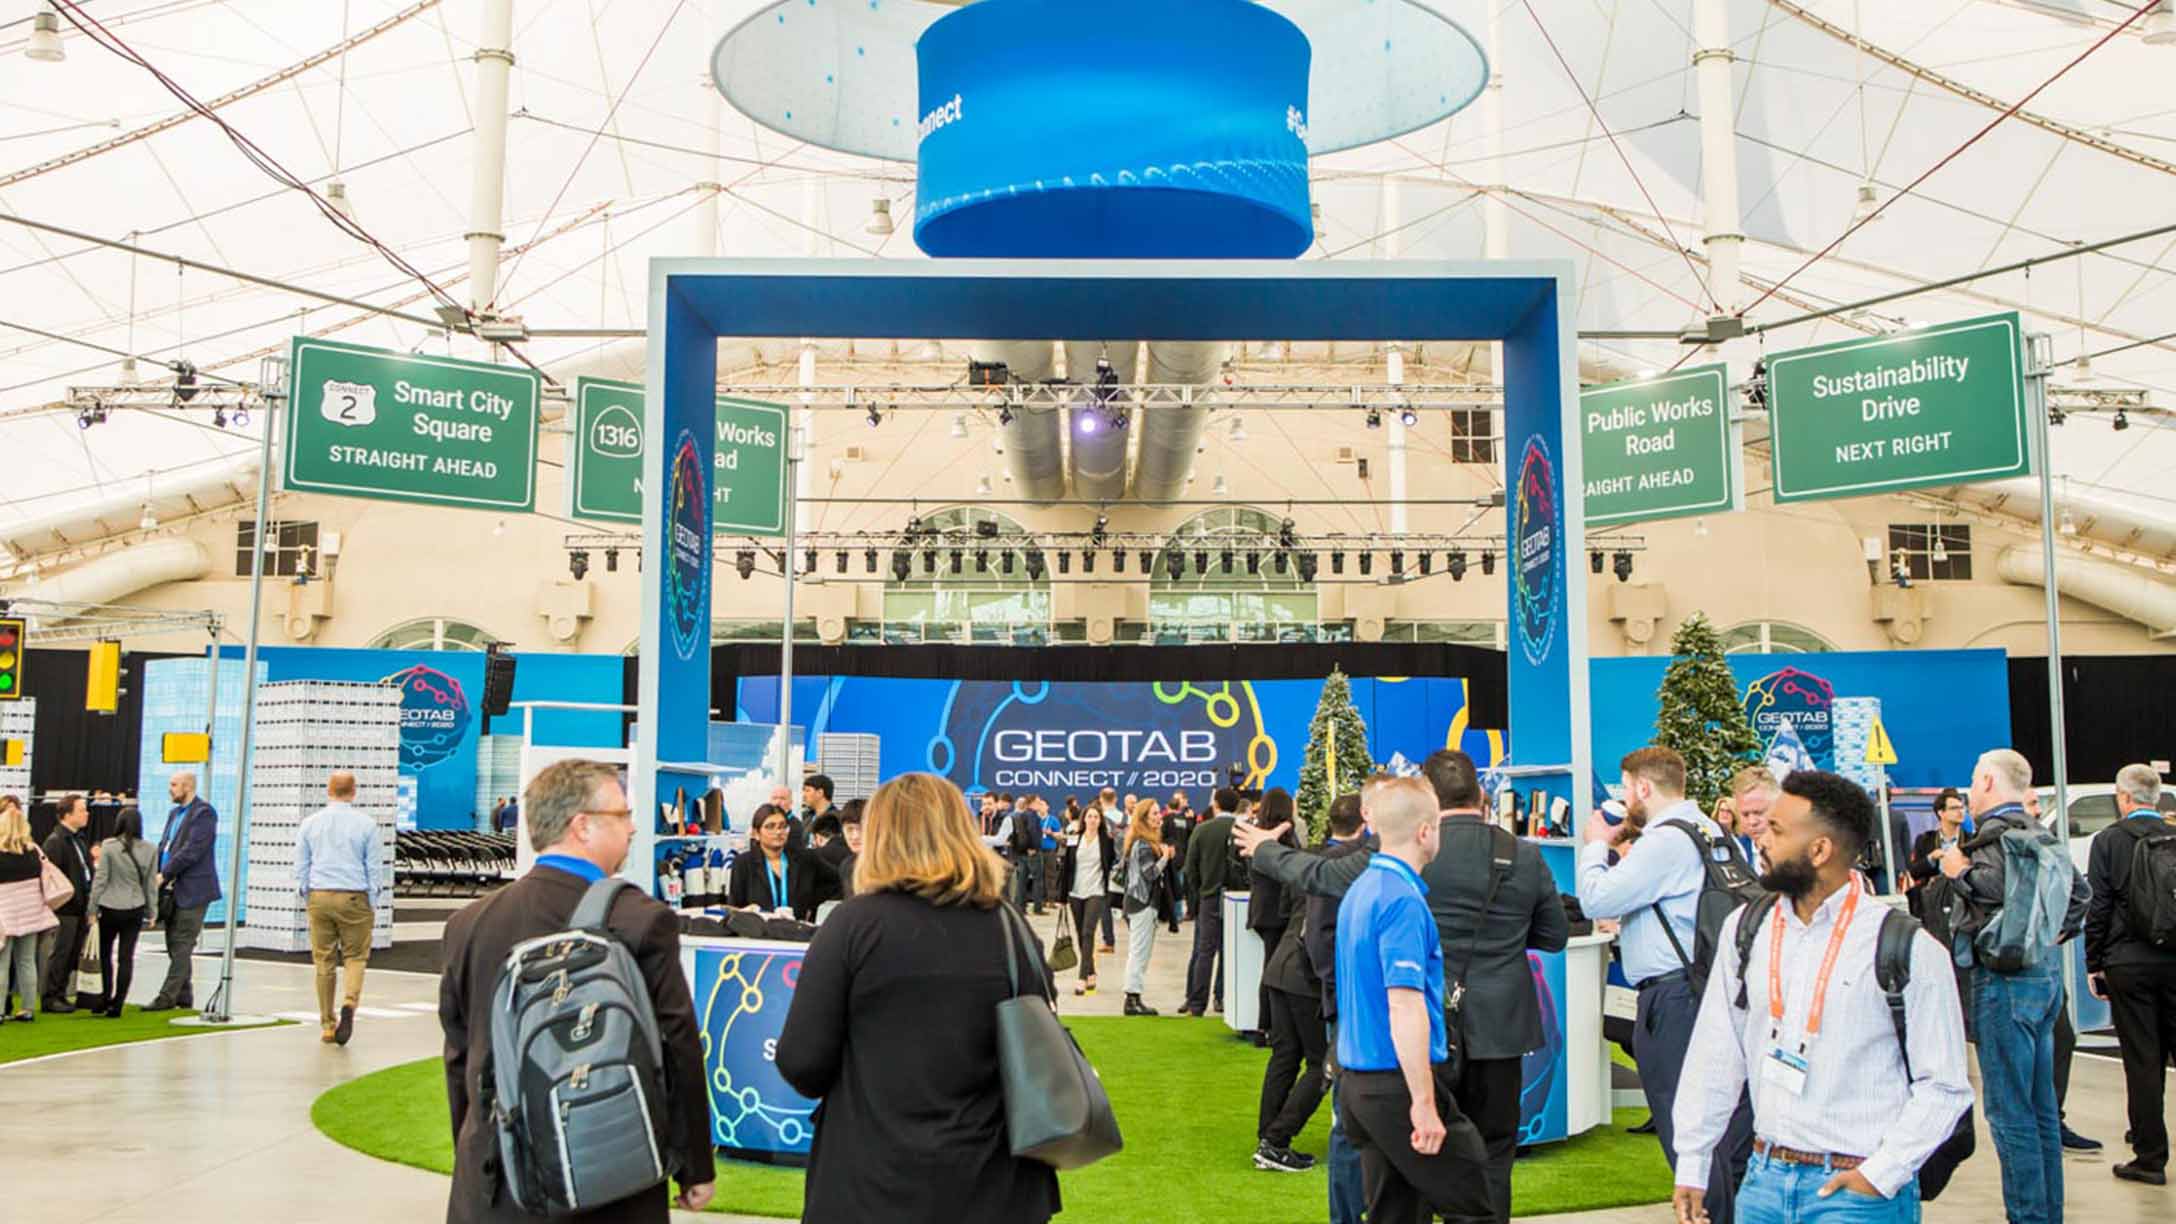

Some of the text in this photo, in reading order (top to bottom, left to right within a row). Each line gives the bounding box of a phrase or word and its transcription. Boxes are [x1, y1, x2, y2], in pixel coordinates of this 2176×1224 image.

[917, 93, 963, 143] nnect
[1812, 355, 1969, 399] Sustainability
[340, 395, 357, 420] 2
[394, 381, 514, 421] Smart City
[1587, 395, 1714, 433] Public Works
[1861, 395, 1921, 422] Drive
[413, 412, 493, 442] Square
[597, 423, 639, 448] 1316
[716, 421, 776, 448] Works
[1625, 428, 1675, 456] Road
[329, 444, 498, 479] STRAIGHT AHEAD
[714, 449, 738, 470] ad
[1835, 431, 1953, 464] NEXT RIGHT
[1583, 467, 1695, 497] AIGHT AHEAD
[400, 708, 456, 721] EOTAB
[994, 730, 1217, 763] GEOTAB
[995, 770, 1125, 788] CONNECT
[1142, 770, 1217, 788] 2020
